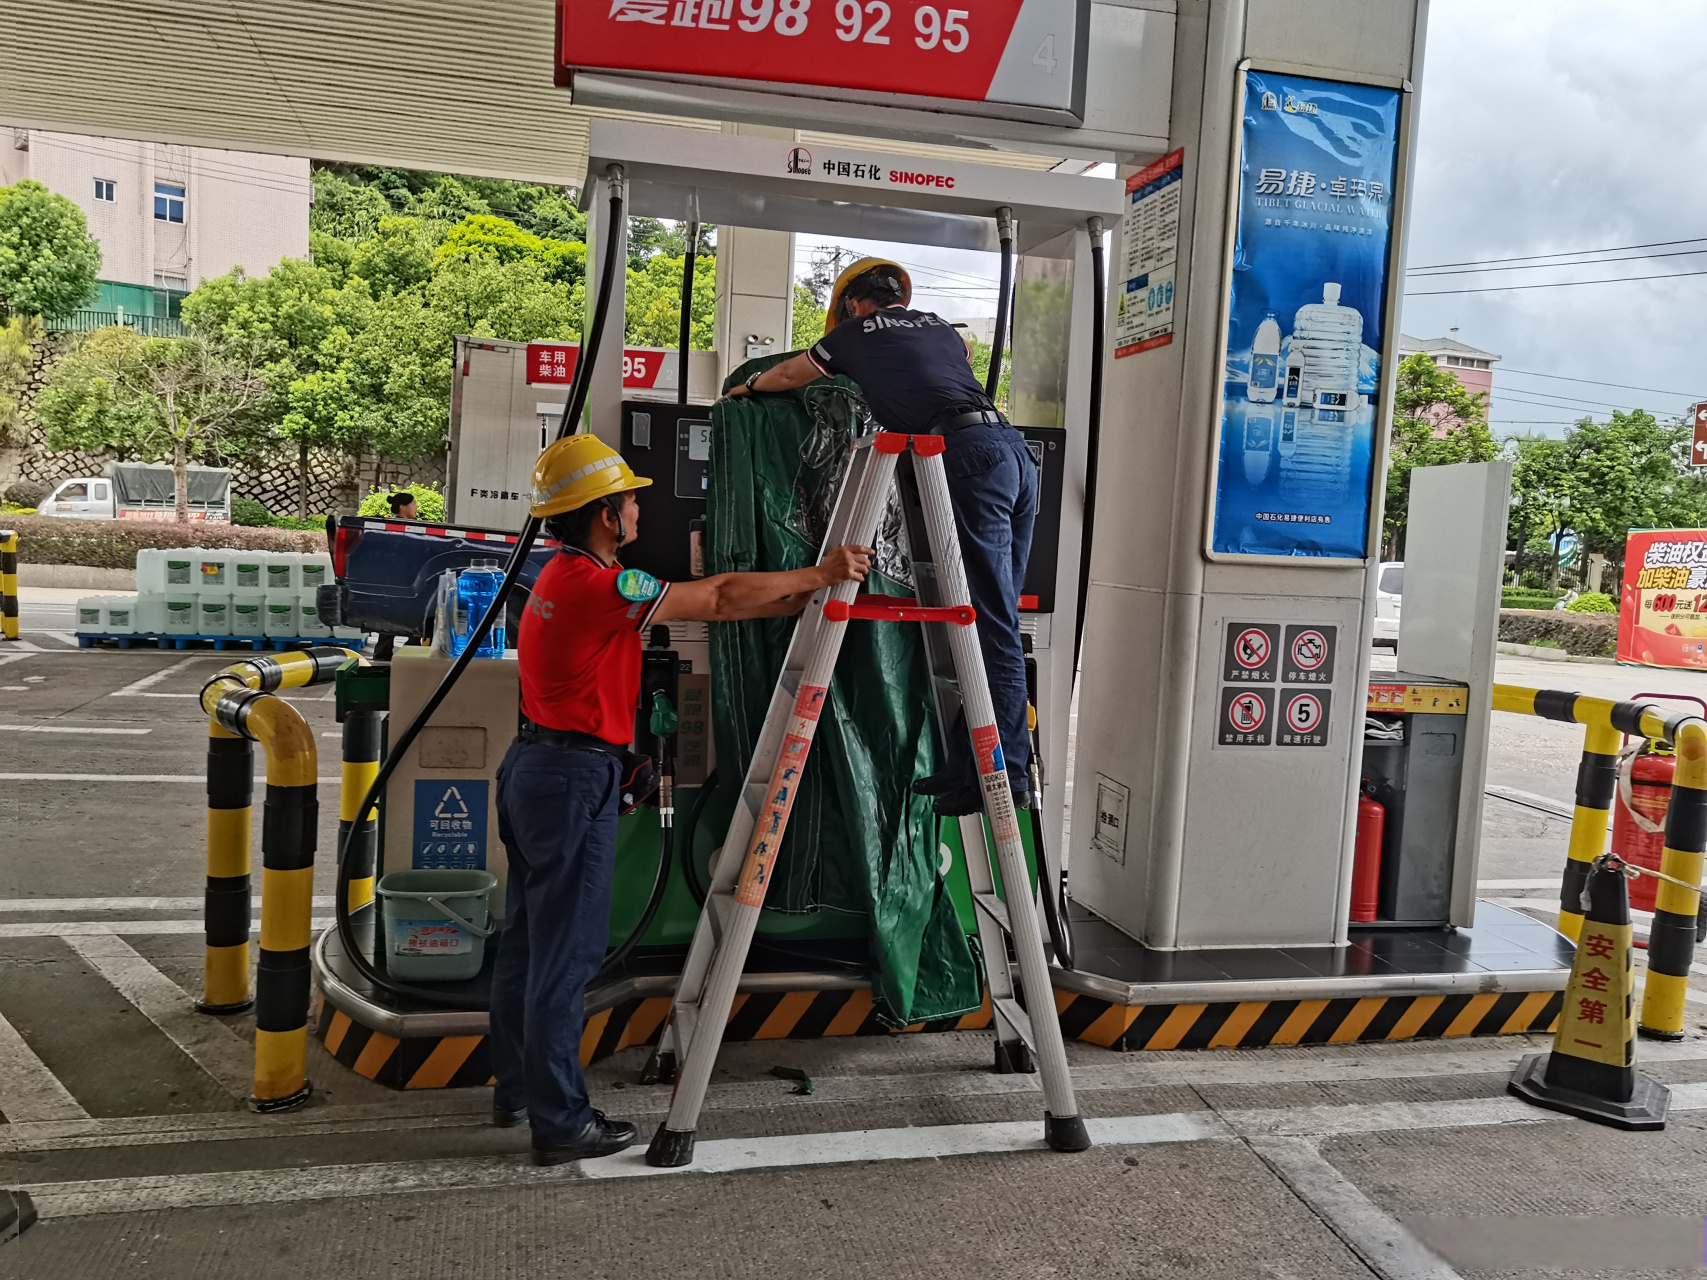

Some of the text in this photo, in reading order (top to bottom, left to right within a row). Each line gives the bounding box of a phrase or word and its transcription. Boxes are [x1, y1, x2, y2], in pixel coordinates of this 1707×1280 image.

[834, 0, 891, 45] 92
[914, 5, 970, 53] 95
[1031, 33, 1058, 75] 4
[823, 159, 955, 189] 中国石化 SINOPEC
[1256, 196, 1383, 219] TIBET GLACIAL WATER
[539, 350, 566, 364] 车用
[539, 364, 566, 378] 柴油
[623, 356, 646, 379] 95
[666, 369, 674, 381] 2
[680, 663, 691, 671] 22
[1231, 669, 1270, 680] 严禁烟火
[1288, 671, 1327, 681] 停车熄火
[1297, 703, 1310, 723] 5
[1225, 733, 1265, 744] 禁用手机
[1283, 734, 1322, 744] 限速行驶
[430, 819, 472, 830] 可回收物
[1574, 933, 1614, 1049] 安全第一
